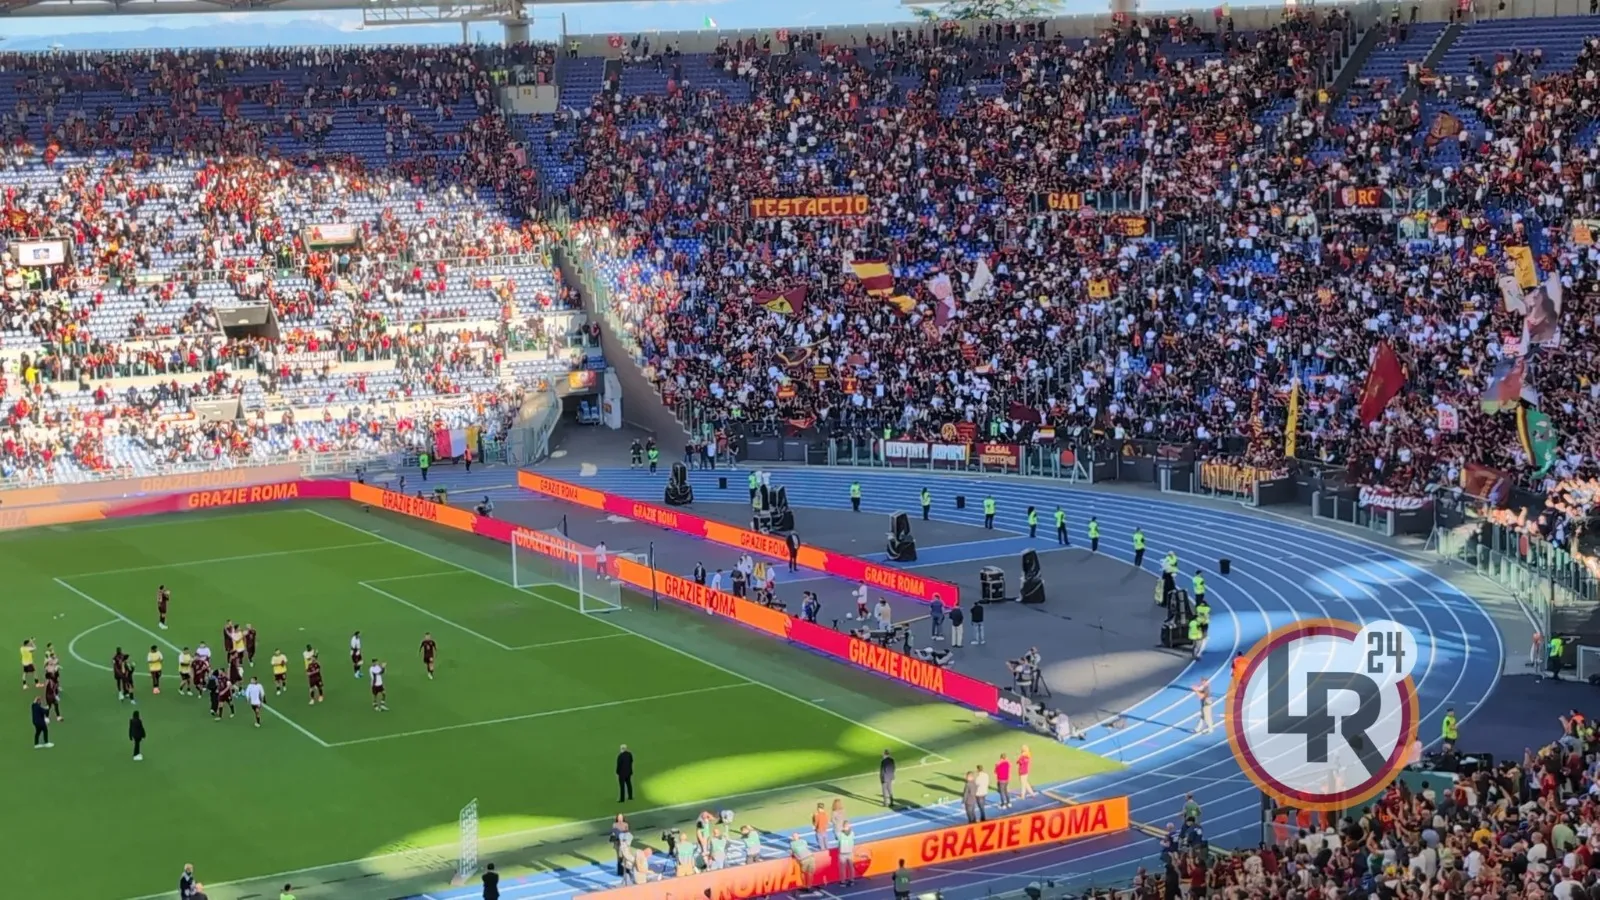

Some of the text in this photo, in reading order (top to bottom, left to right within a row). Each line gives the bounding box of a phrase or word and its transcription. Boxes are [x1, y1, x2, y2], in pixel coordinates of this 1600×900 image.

[752, 197, 867, 216] TESTACCIO
[140, 469, 246, 491] GRAZIE ROMA
[540, 479, 578, 500] GRAZIE ROMA
[188, 483, 298, 508] GRAZIE ROMA
[382, 490, 437, 520] GRAZIE ROMA
[633, 503, 678, 528] GRAZIE ROMA
[741, 532, 767, 551] GRAZIE
[864, 566, 925, 597] GRAZIE ROMA
[665, 576, 736, 618] GRAZIE ROMA
[849, 639, 944, 693] GRAZIE ROMA
[921, 804, 1108, 863] GRAZIE ROMA
